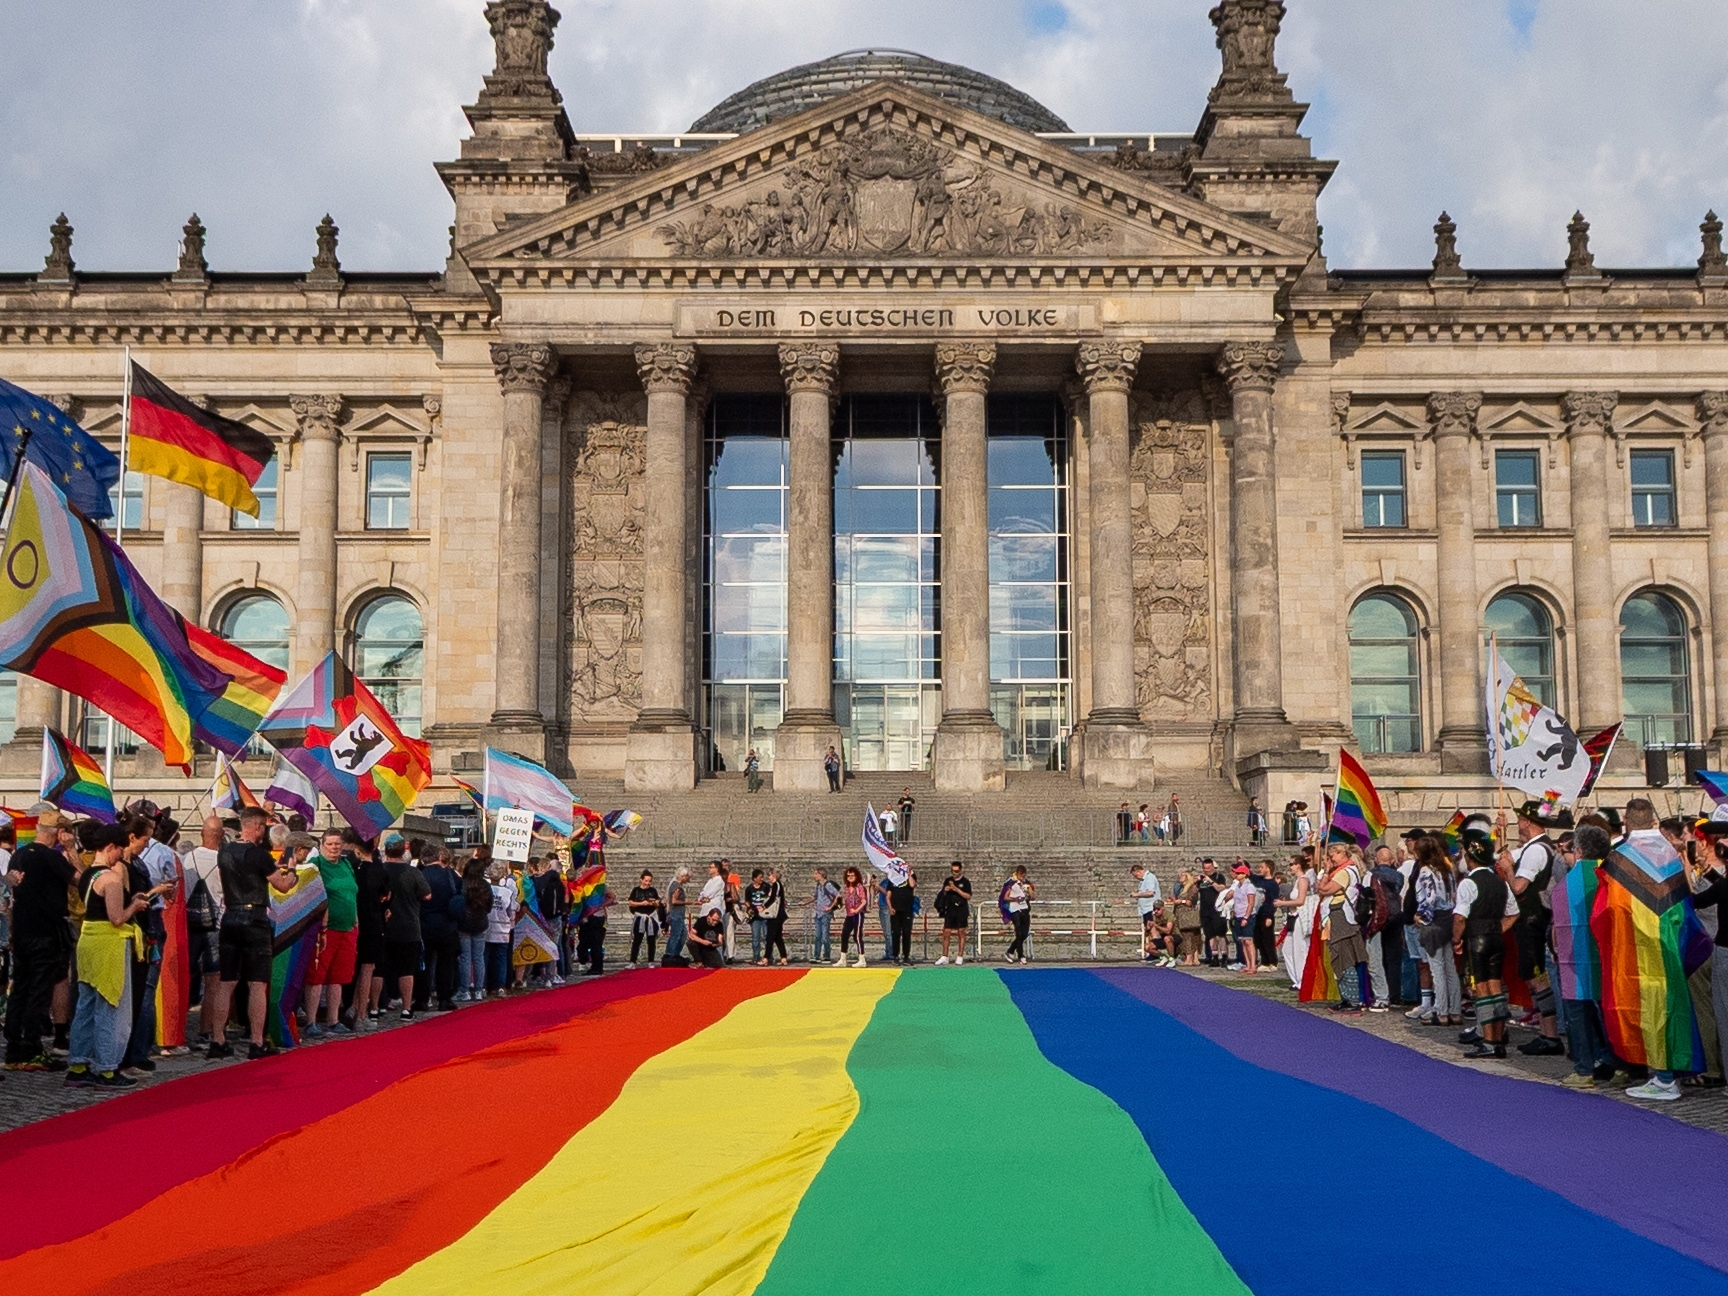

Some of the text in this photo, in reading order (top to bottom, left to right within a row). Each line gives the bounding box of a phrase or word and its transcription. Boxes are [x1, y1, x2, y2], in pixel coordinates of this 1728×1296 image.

[716, 308, 1058, 327] DEM DEUTSCHEN VOLKE
[502, 814, 528, 824] OMAS
[499, 827, 528, 837] GEGEN
[496, 839, 528, 850] RECHTS
